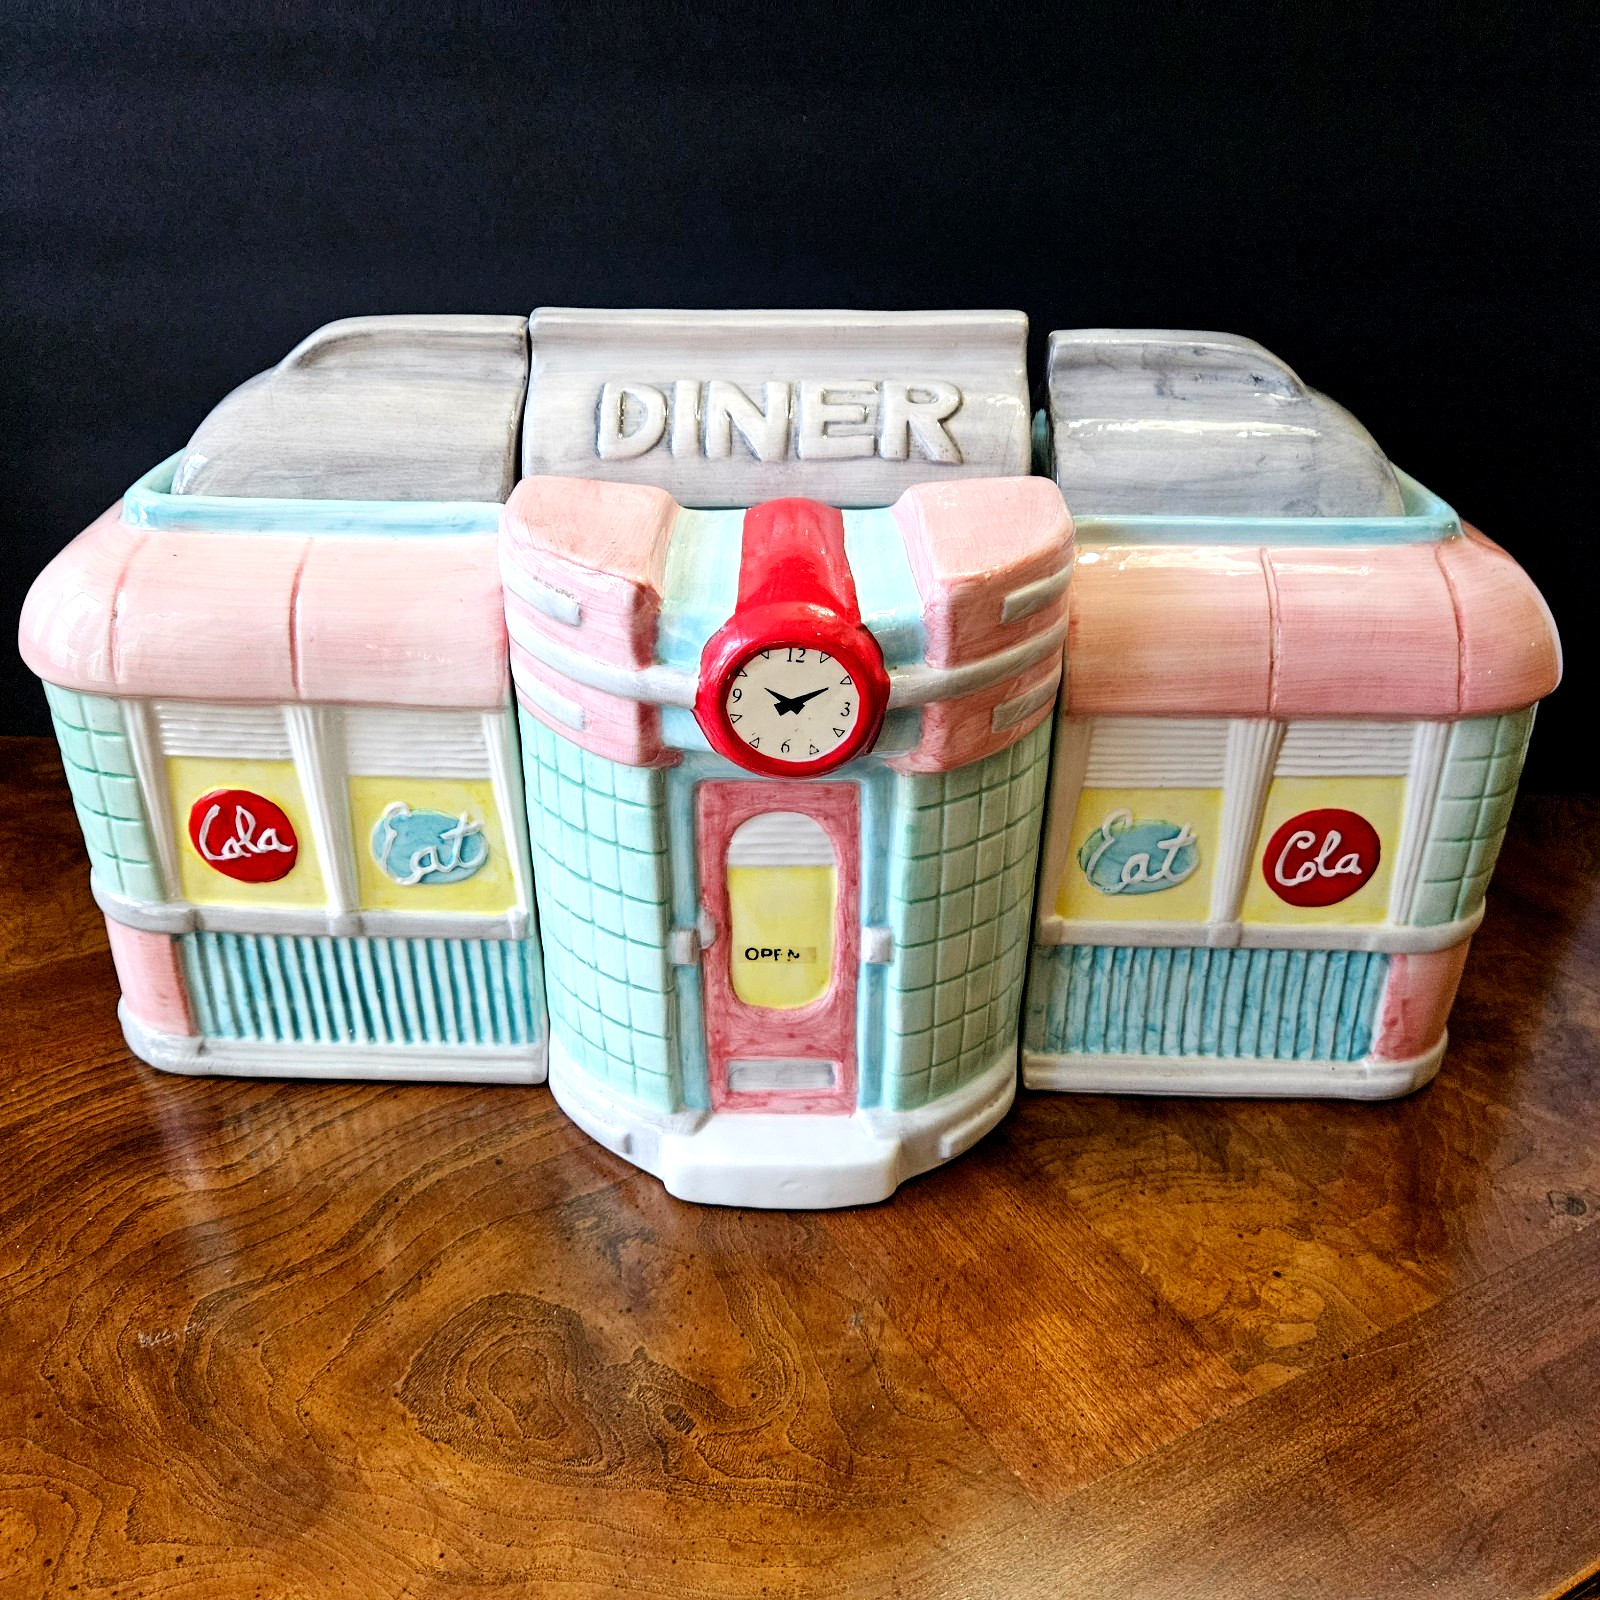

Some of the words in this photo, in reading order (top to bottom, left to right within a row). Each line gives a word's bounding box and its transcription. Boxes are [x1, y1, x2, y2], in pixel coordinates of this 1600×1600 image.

[596, 380, 963, 464] DINER
[787, 647, 806, 663] 12
[732, 688, 743, 704] 9
[840, 701, 851, 717] 3
[780, 738, 791, 754] 6
[198, 803, 294, 861] Cola
[378, 801, 490, 886] Eat
[1085, 808, 1199, 895] Eat
[1274, 830, 1362, 887] Cola
